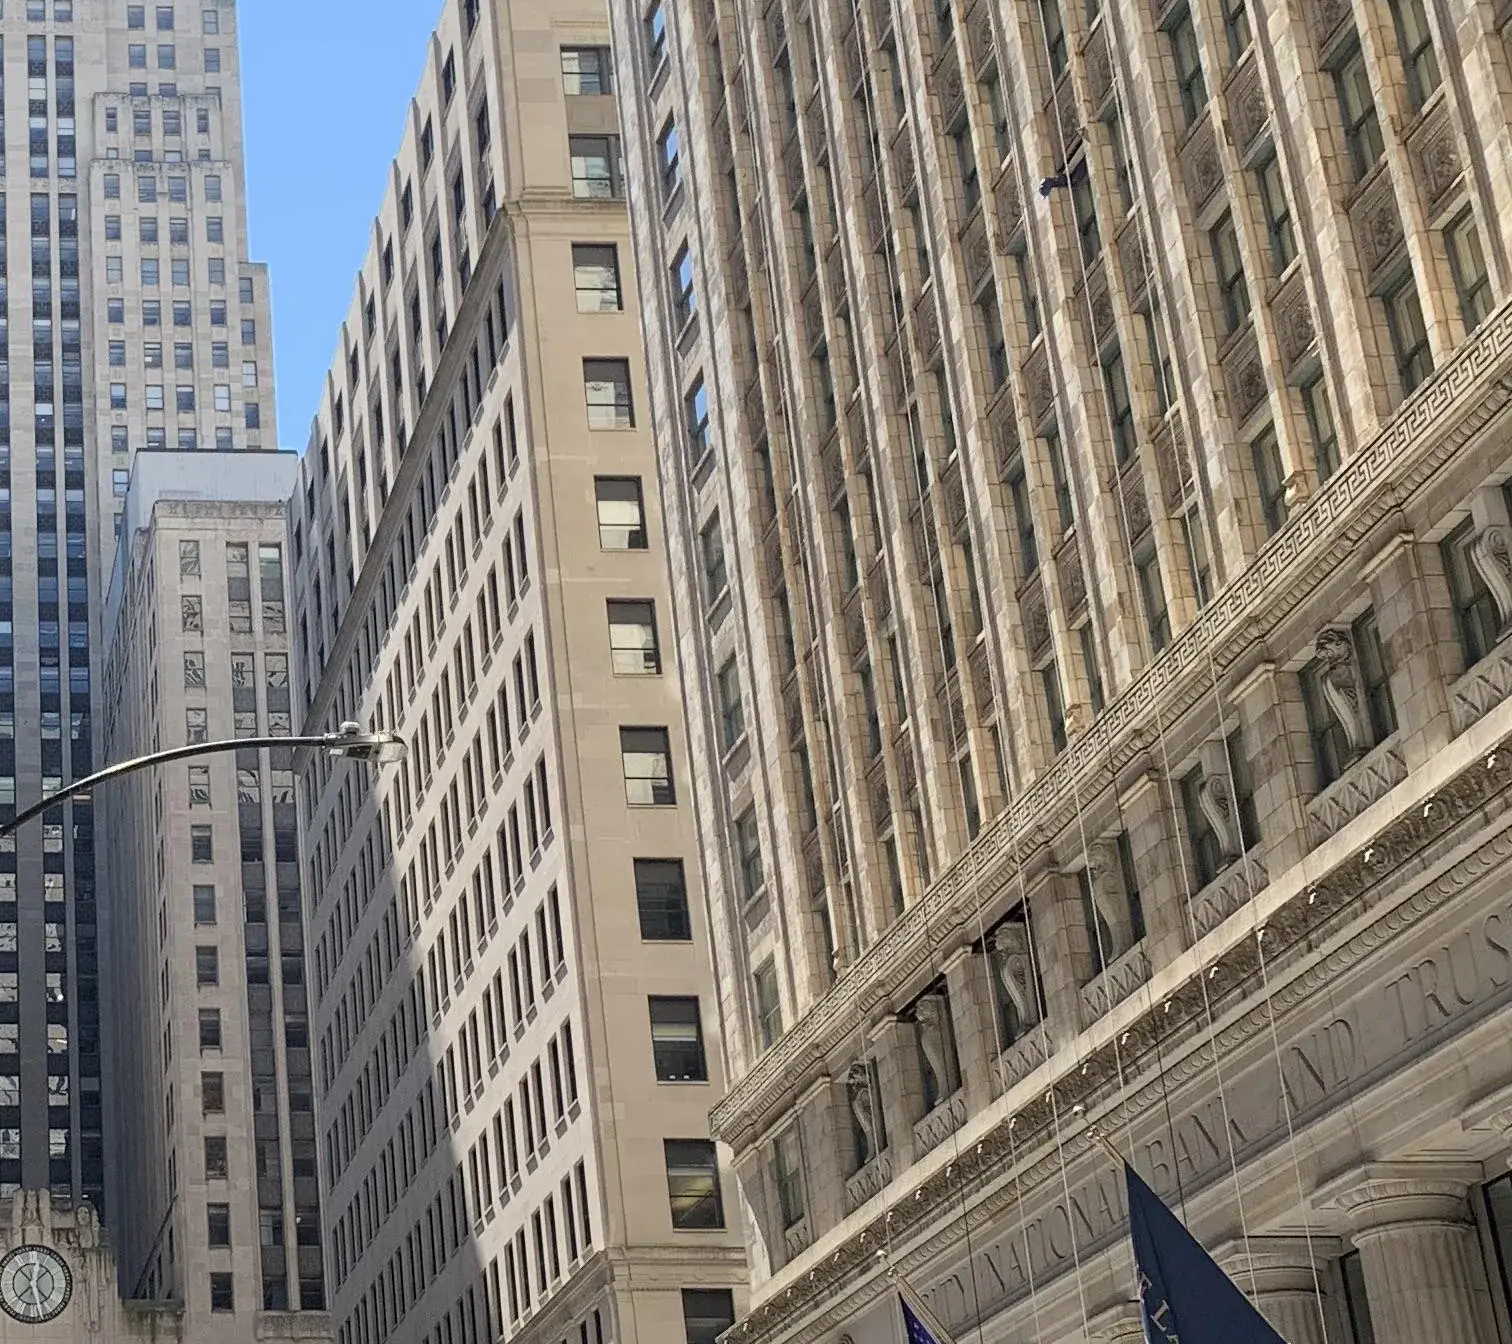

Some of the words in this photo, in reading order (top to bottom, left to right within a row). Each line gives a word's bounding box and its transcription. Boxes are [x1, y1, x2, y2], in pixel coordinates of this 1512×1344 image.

[1144, 1092, 1249, 1196] BANK
[1275, 1018, 1355, 1123] AND
[1385, 904, 1512, 1044] TRUS
